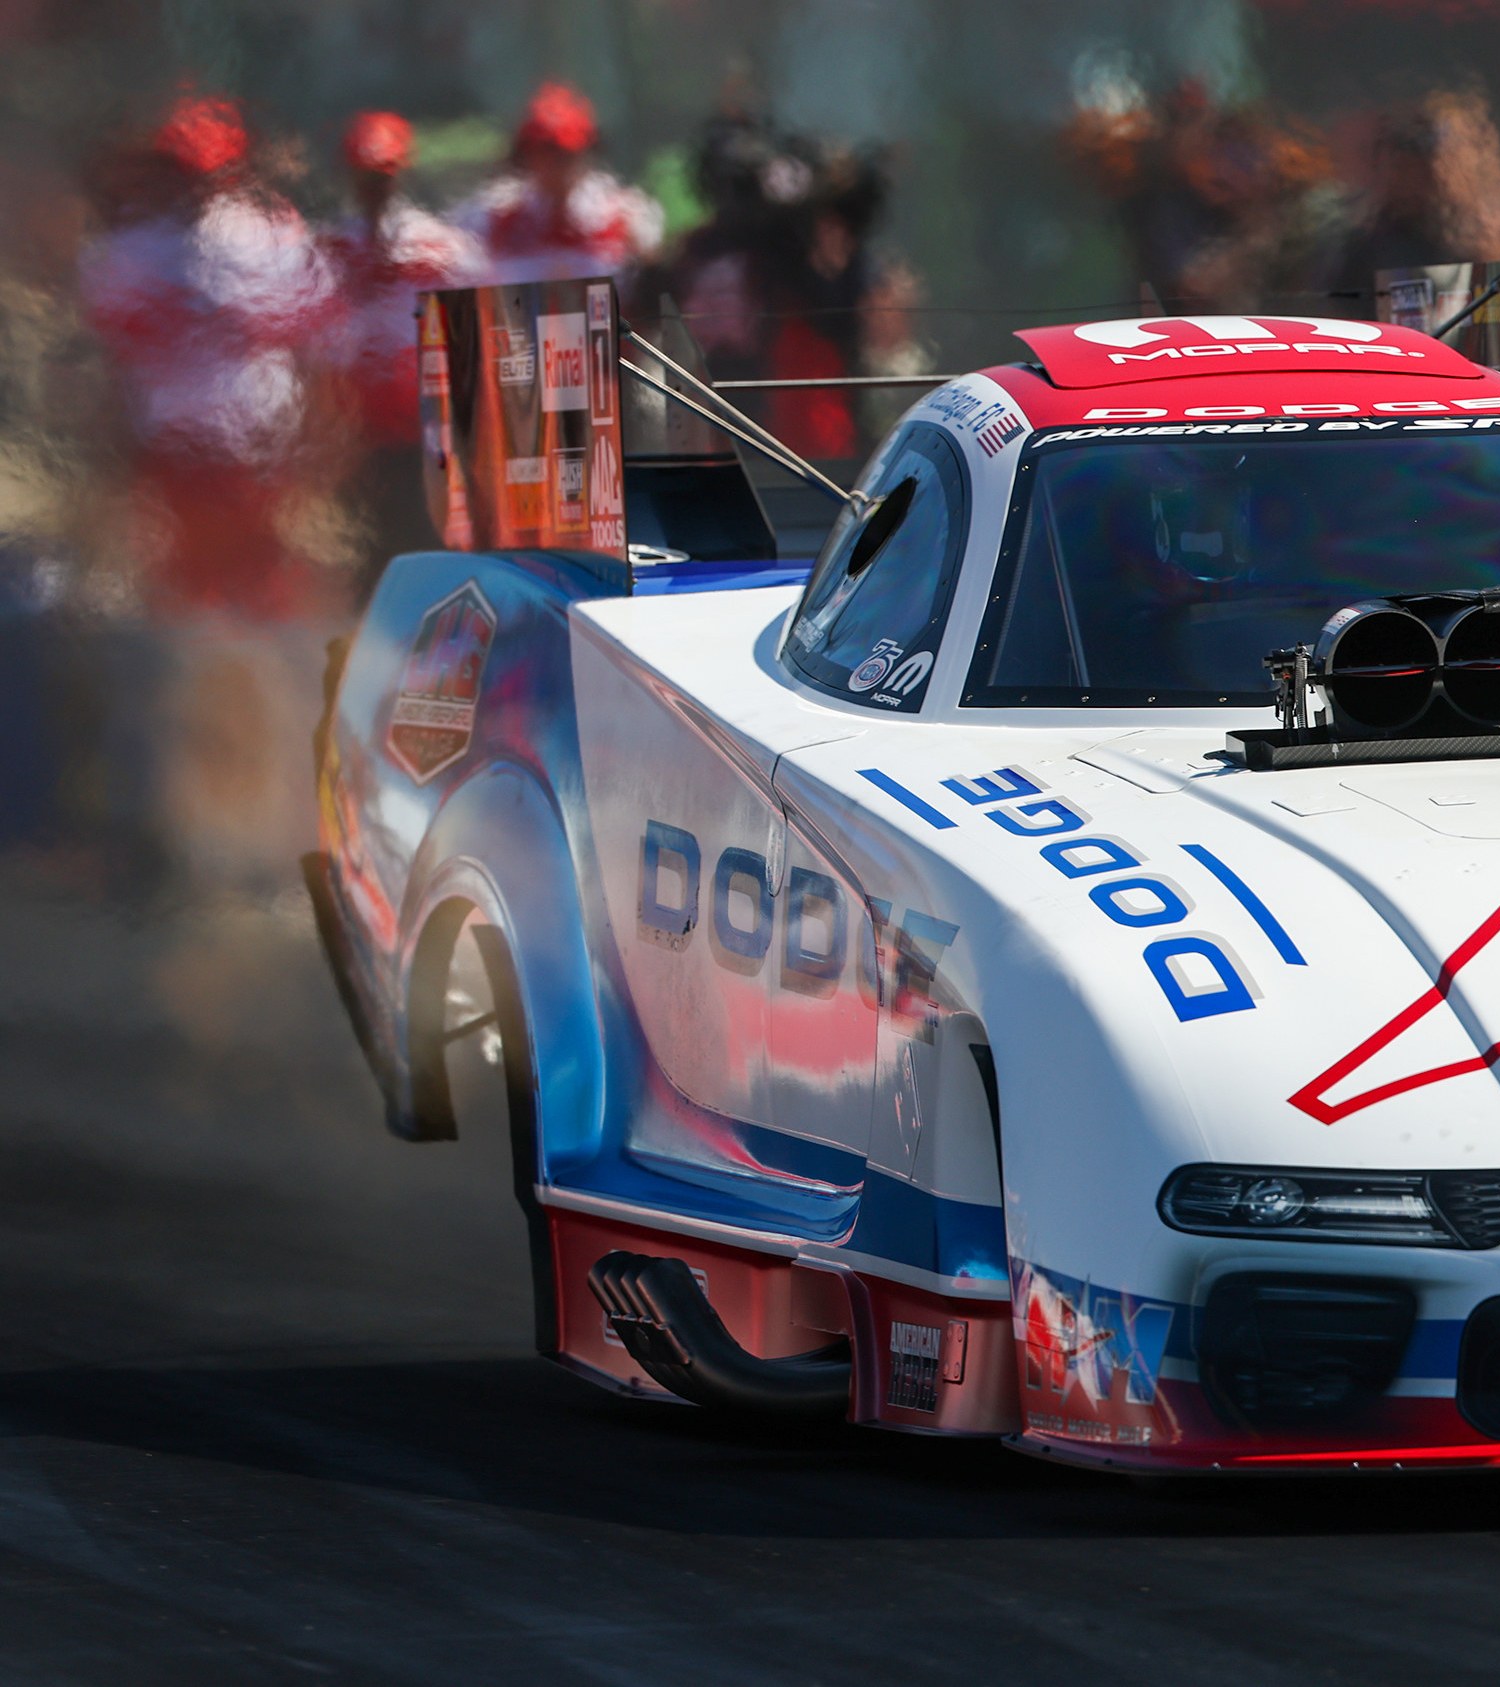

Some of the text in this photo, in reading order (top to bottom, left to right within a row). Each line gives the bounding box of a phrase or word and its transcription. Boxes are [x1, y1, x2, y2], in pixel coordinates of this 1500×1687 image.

[544, 337, 585, 388] Rinnai
[1107, 342, 1406, 365] MOPAR
[1031, 422, 1309, 448] POWERED
[1317, 421, 1398, 431] BY
[591, 520, 625, 547] TOOLS
[871, 692, 902, 707] MOPAR
[939, 766, 1262, 1022] DODGE
